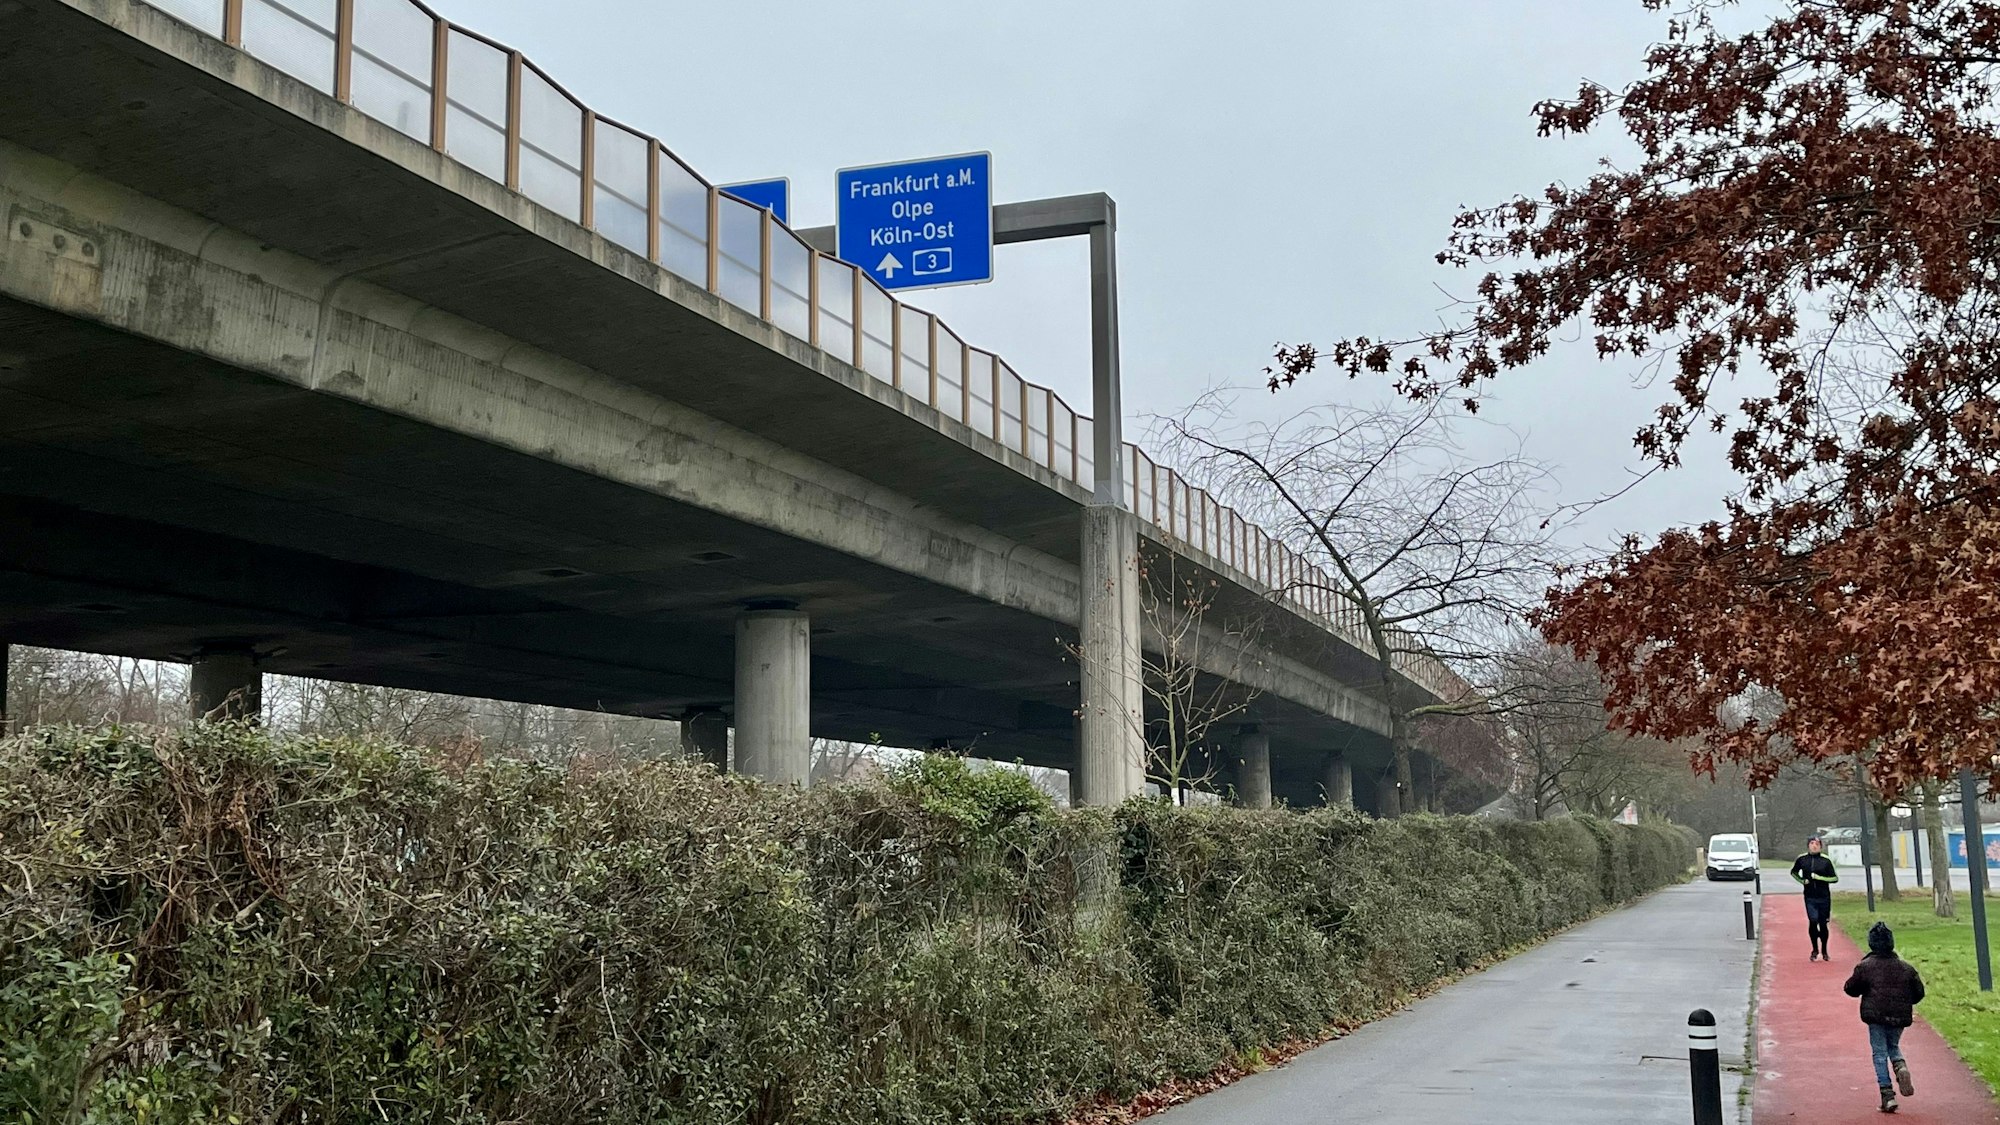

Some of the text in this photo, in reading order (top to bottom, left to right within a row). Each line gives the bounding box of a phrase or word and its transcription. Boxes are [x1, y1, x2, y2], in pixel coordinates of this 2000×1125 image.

[850, 168, 975, 199] Frankfurt a.M.
[892, 200, 934, 221] Olpe
[870, 221, 954, 246] Köln-Ost
[928, 254, 937, 269] 3
